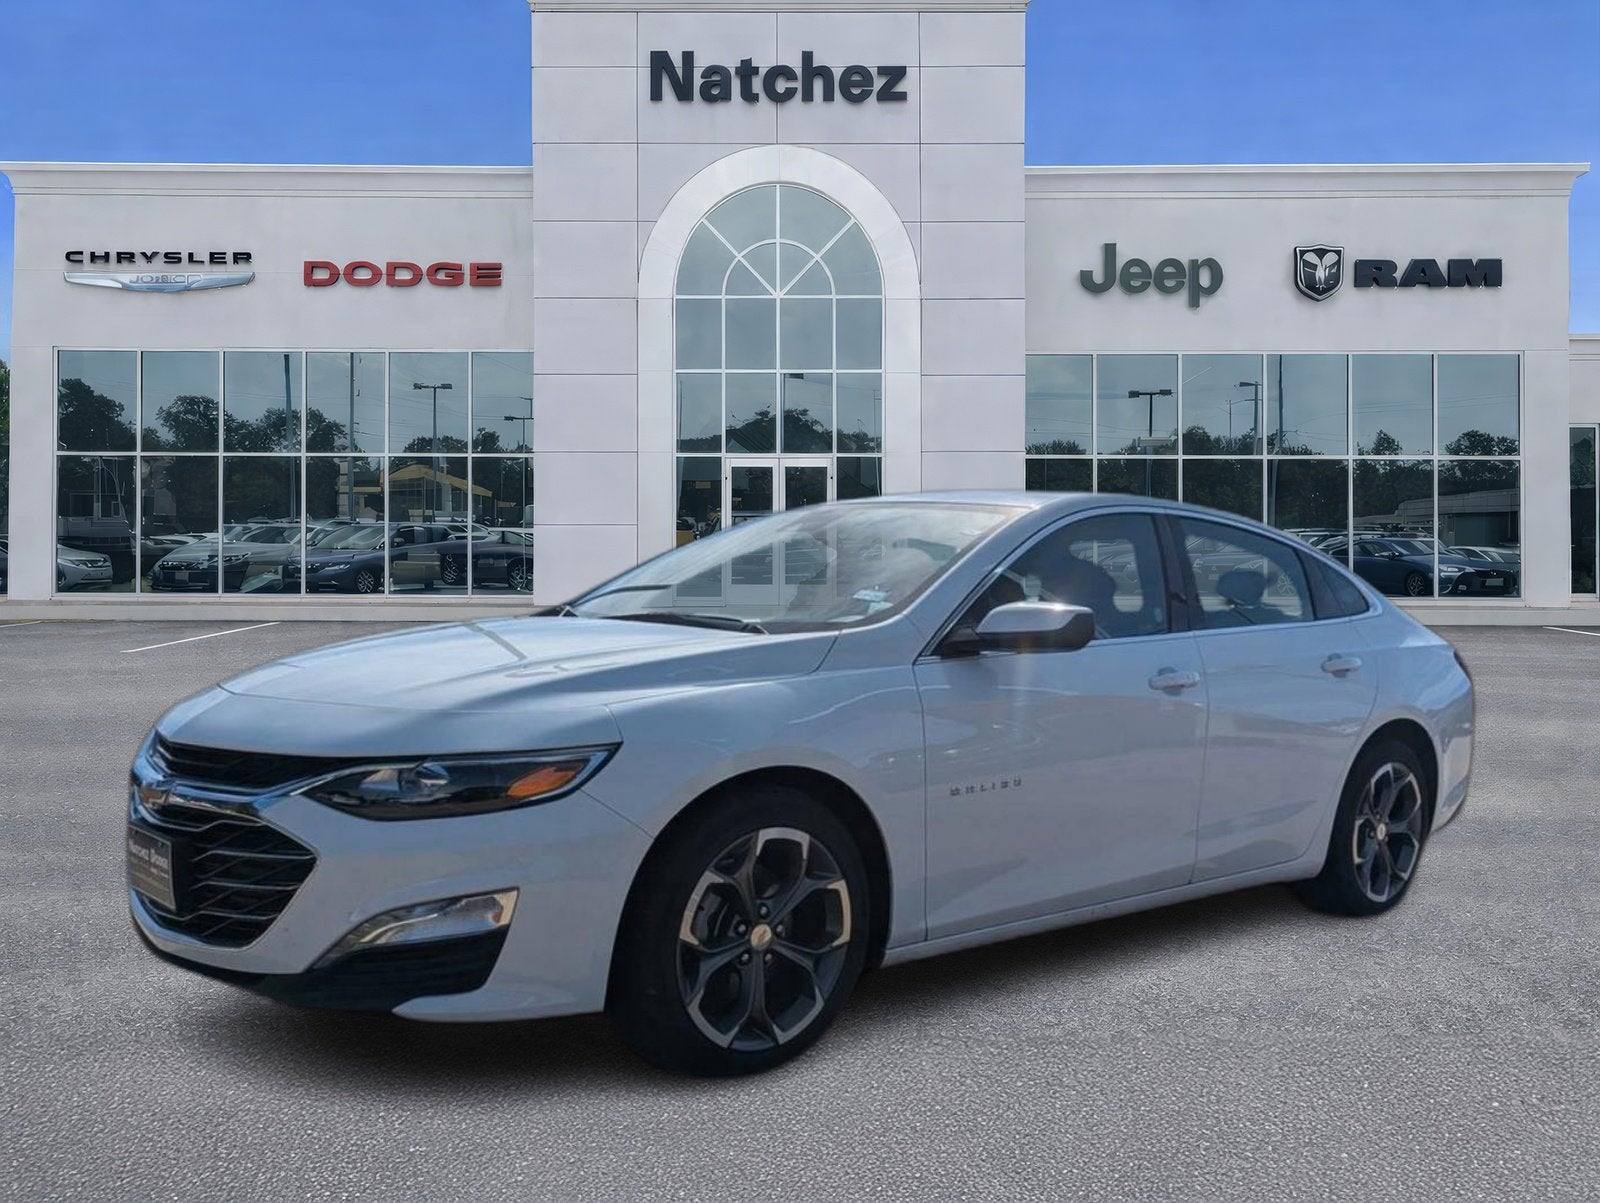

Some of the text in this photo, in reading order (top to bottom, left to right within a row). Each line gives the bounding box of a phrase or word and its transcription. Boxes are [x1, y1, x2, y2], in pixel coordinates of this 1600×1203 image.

[650, 50, 908, 103] Natchez
[65, 251, 252, 264] CHRYSLER
[303, 260, 502, 286] DODGE
[1080, 243, 1223, 308] Jeep
[1354, 258, 1502, 287] RAM
